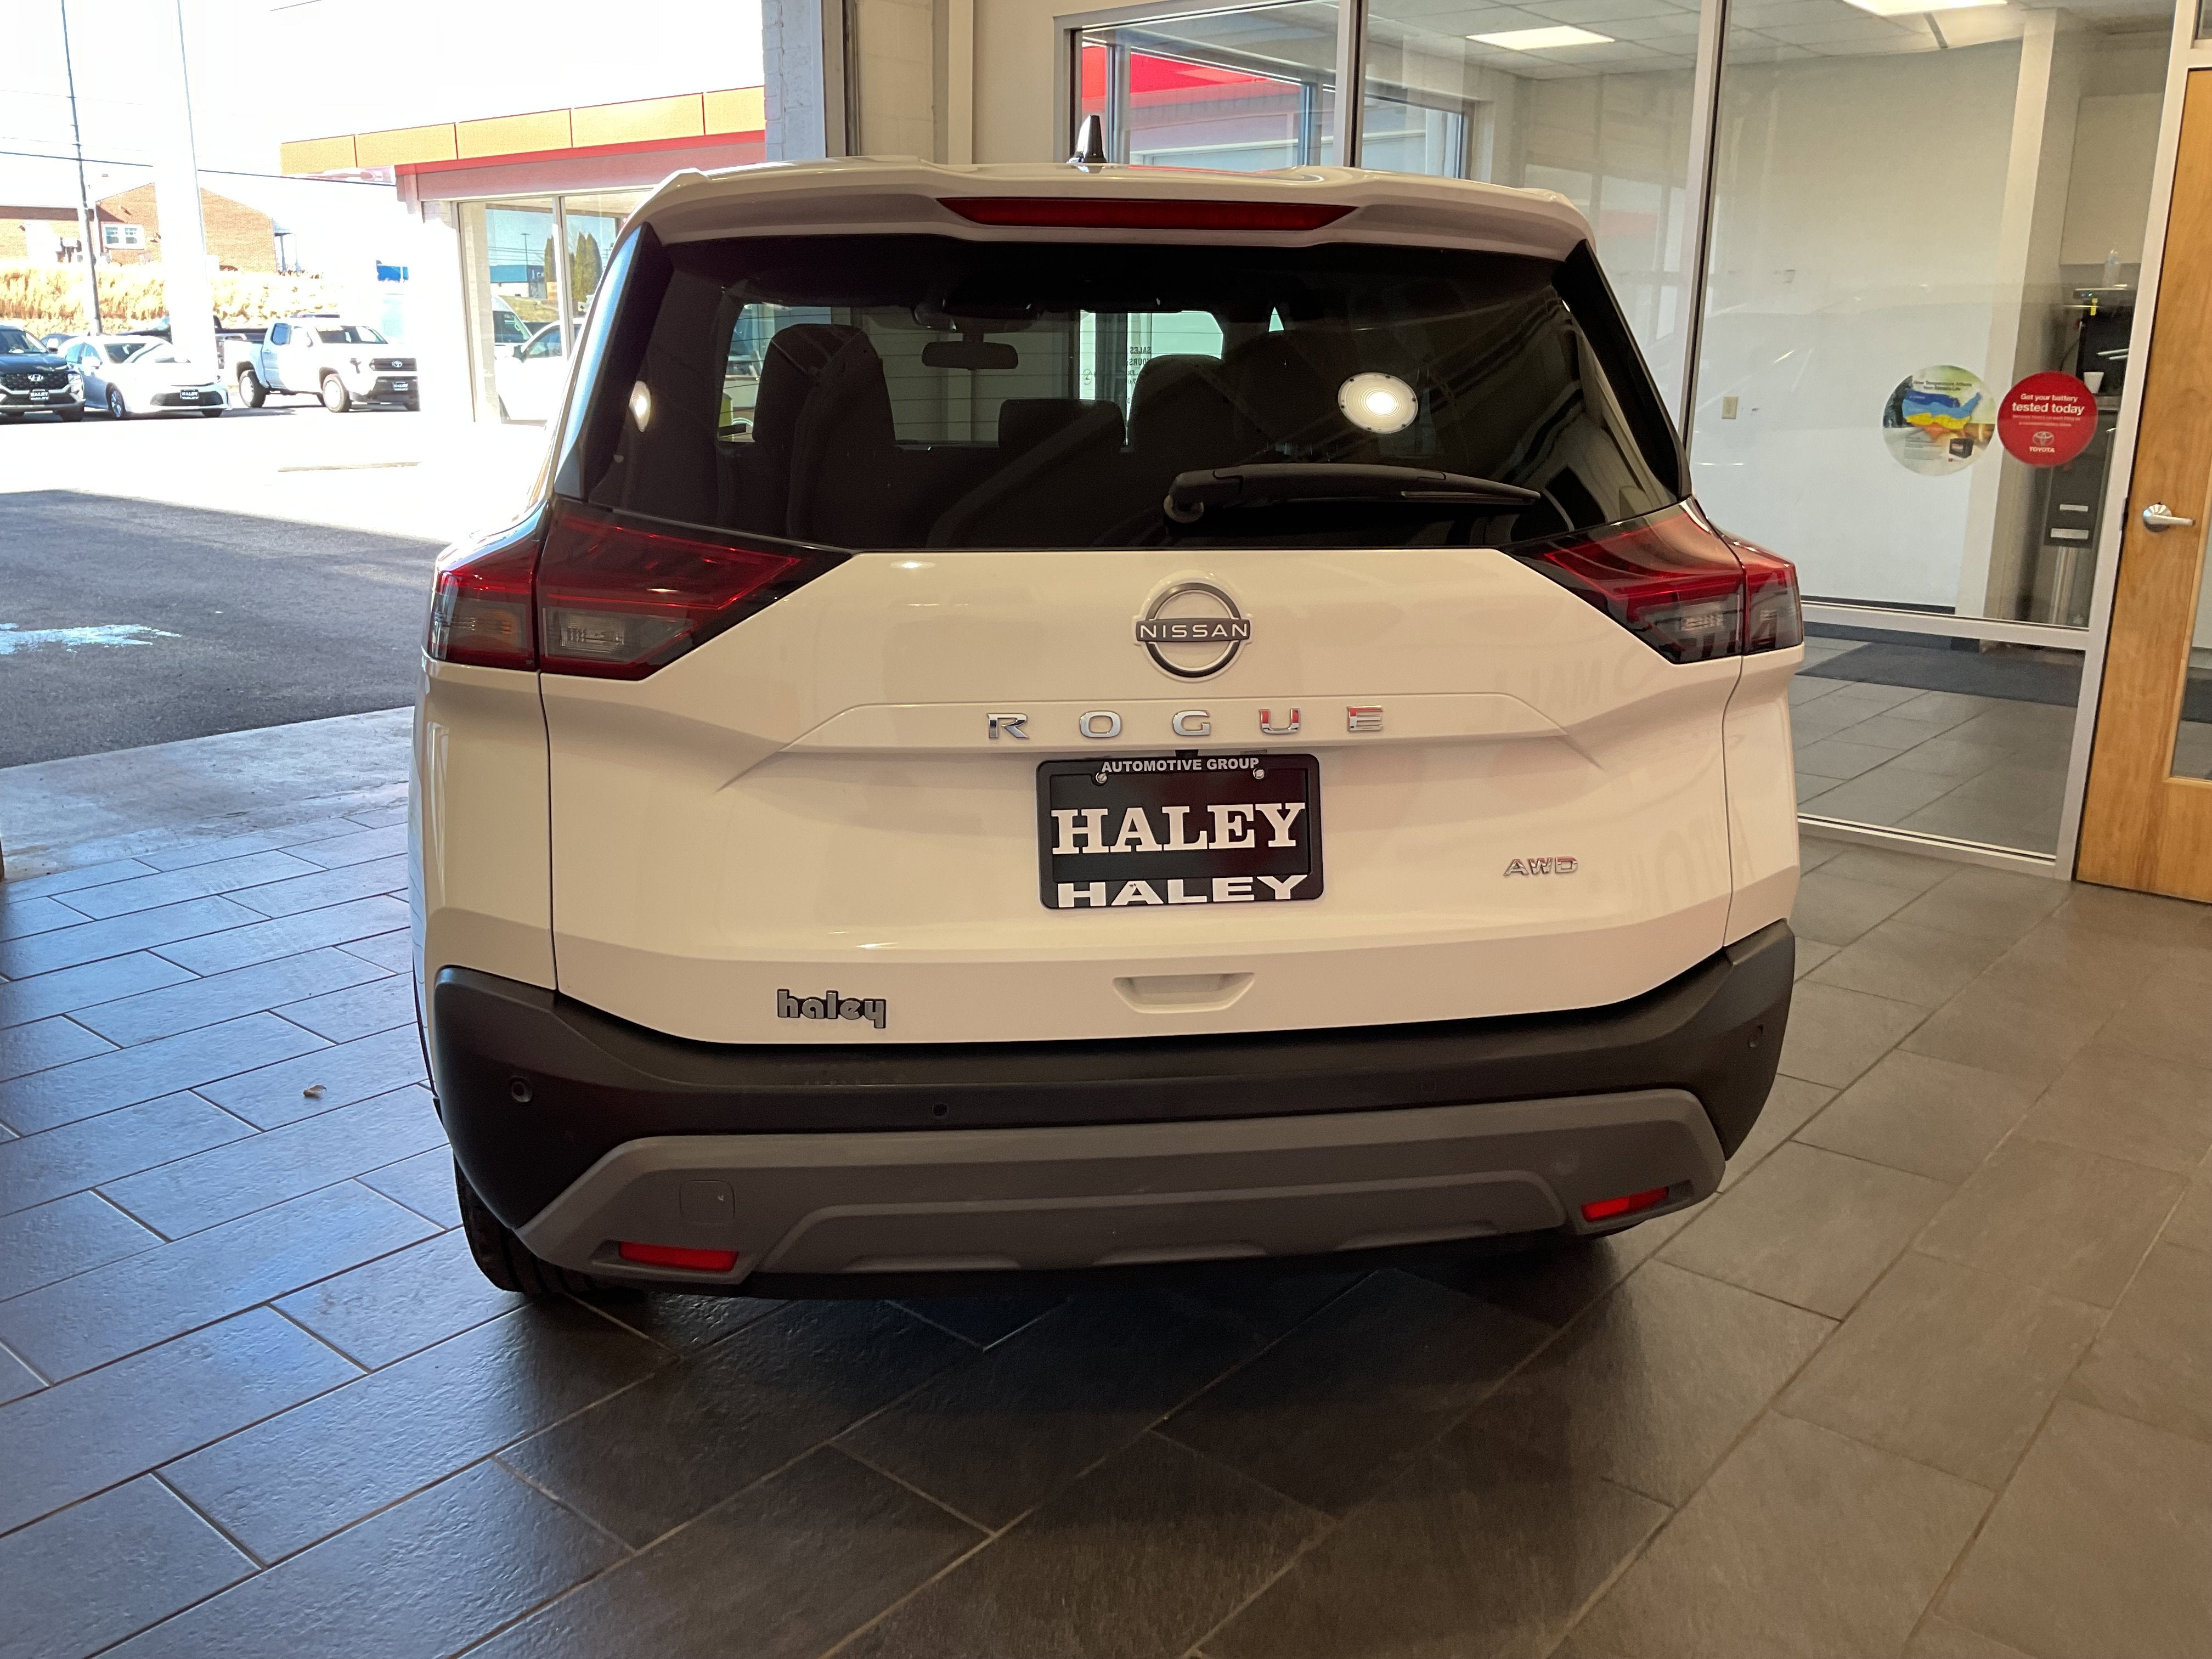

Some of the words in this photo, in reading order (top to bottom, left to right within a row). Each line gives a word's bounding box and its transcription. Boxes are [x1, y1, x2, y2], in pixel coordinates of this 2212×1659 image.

[2012, 402, 2049, 413] tested
[2051, 403, 2085, 416] today
[2052, 394, 2078, 403] battery
[1140, 622, 1249, 640] NISSAN
[986, 705, 1385, 740] ROGUE
[1101, 759, 1203, 774] AUTOMOTIVE
[1206, 757, 1260, 771] GROUP
[1051, 802, 1306, 855] HALEY
[1503, 856, 1578, 877] AWD
[1057, 874, 1308, 909] HALEY
[777, 988, 887, 1029] haley
